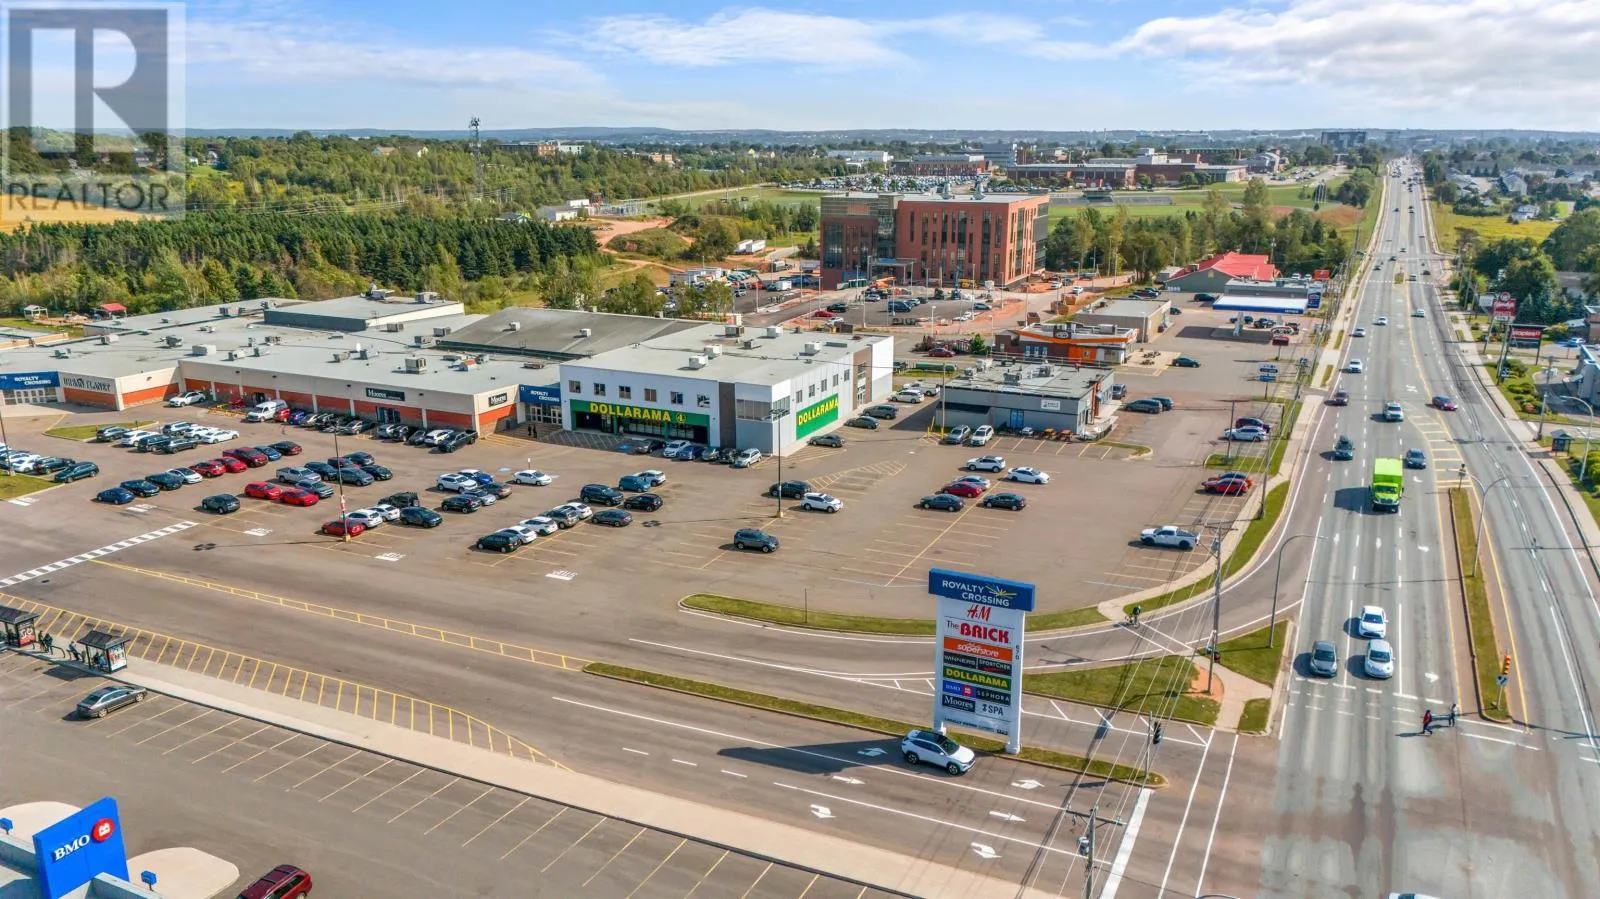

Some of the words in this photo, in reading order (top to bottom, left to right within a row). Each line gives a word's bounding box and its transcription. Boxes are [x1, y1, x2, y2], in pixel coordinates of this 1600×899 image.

[590, 402, 671, 422] DOLLARAMA
[797, 399, 839, 426] DOLLARAMA
[942, 579, 985, 593] ROYALTY
[961, 592, 1010, 607] CROSSING
[947, 620, 960, 630] The
[960, 622, 1009, 644] BRICK
[945, 668, 1008, 688] DOLLARAMA
[943, 695, 974, 710] Moores
[54, 834, 91, 861] BMO
